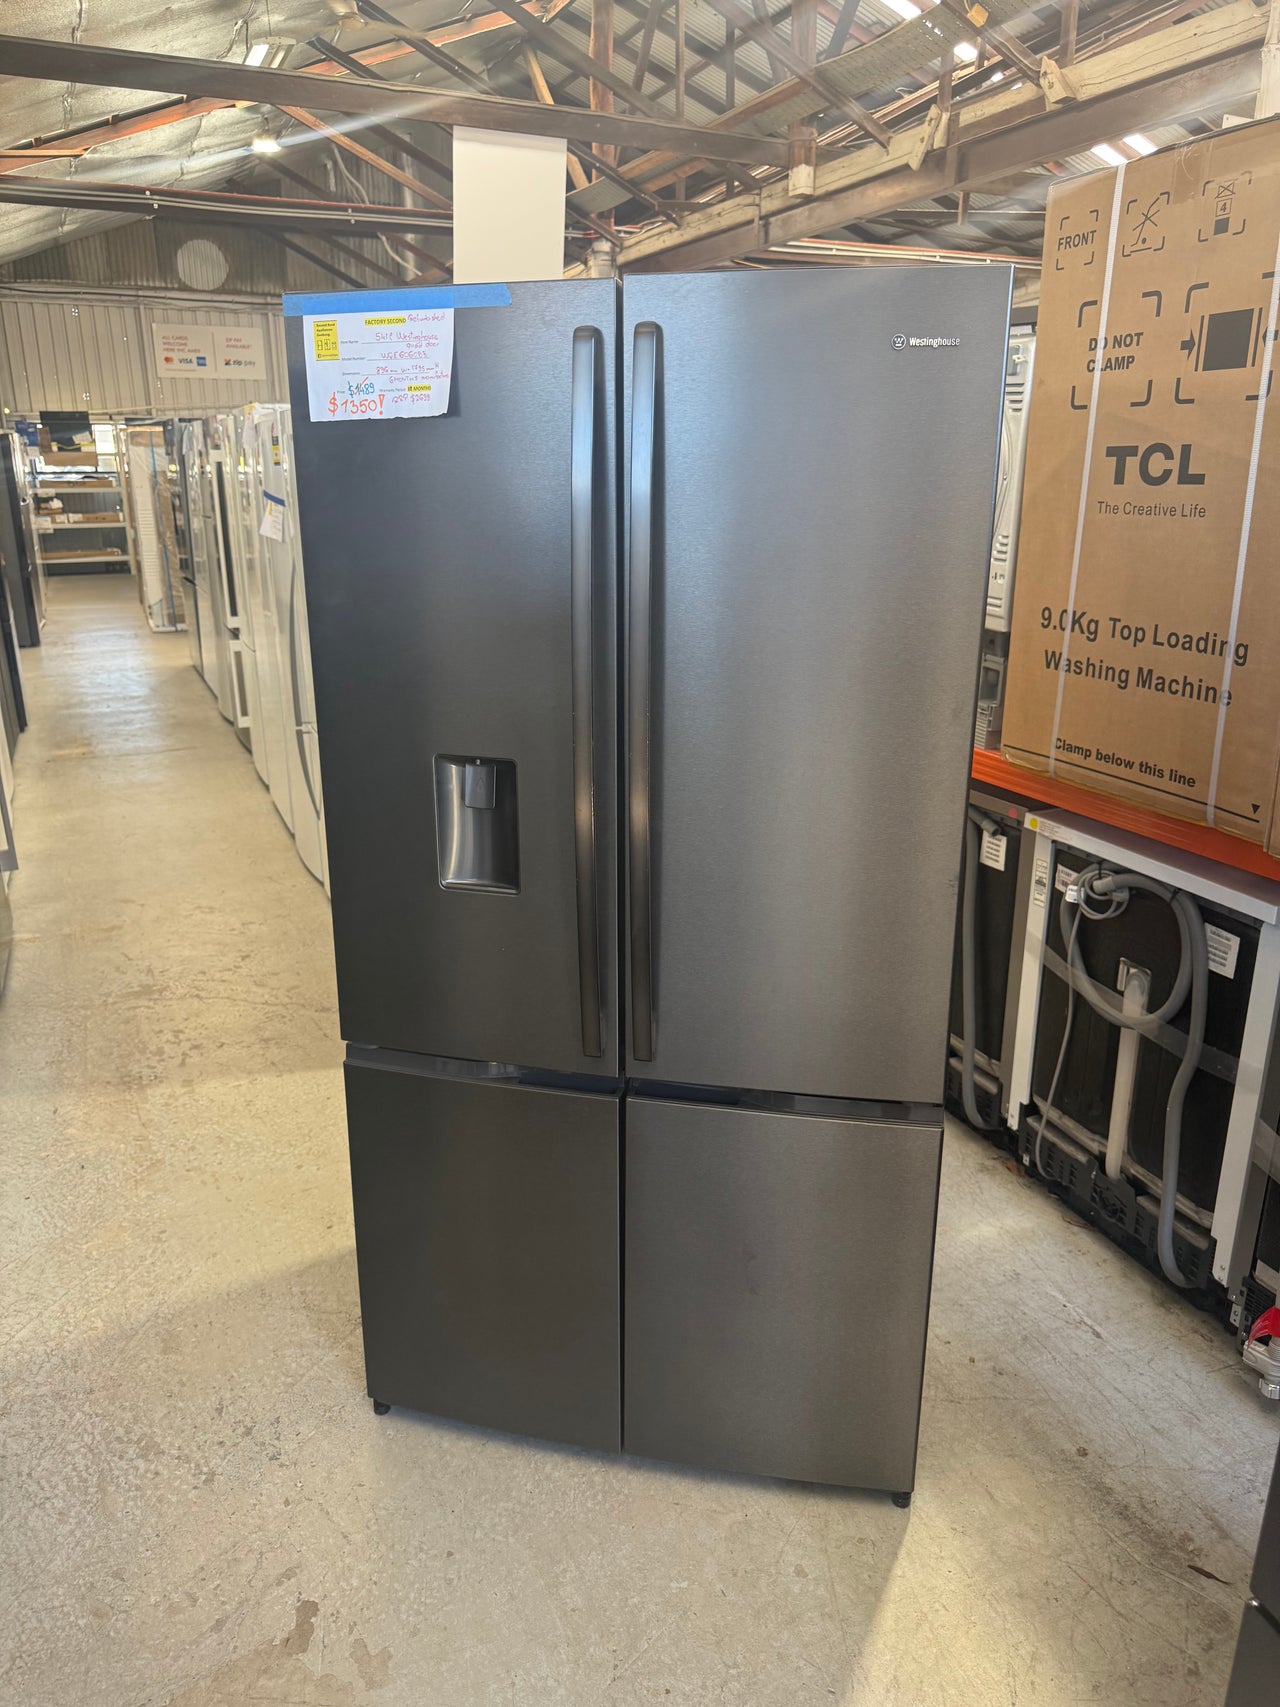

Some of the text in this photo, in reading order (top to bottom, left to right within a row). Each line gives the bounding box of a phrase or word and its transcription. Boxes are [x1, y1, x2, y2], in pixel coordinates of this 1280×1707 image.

[1219, 202, 1228, 214] 4
[1057, 230, 1097, 251] FRONT
[386, 317, 406, 325] SECOND
[909, 336, 961, 348] Westinghouse
[1112, 332, 1144, 349] NOT
[178, 357, 193, 365] VISA
[1105, 442, 1206, 487] TCL
[1097, 501, 1206, 518] The Creative Life
[1041, 606, 1249, 667] 9.0Kg Top Loading
[1044, 649, 1233, 708] Washing Machine
[1055, 737, 1196, 788] Clamp below this line
